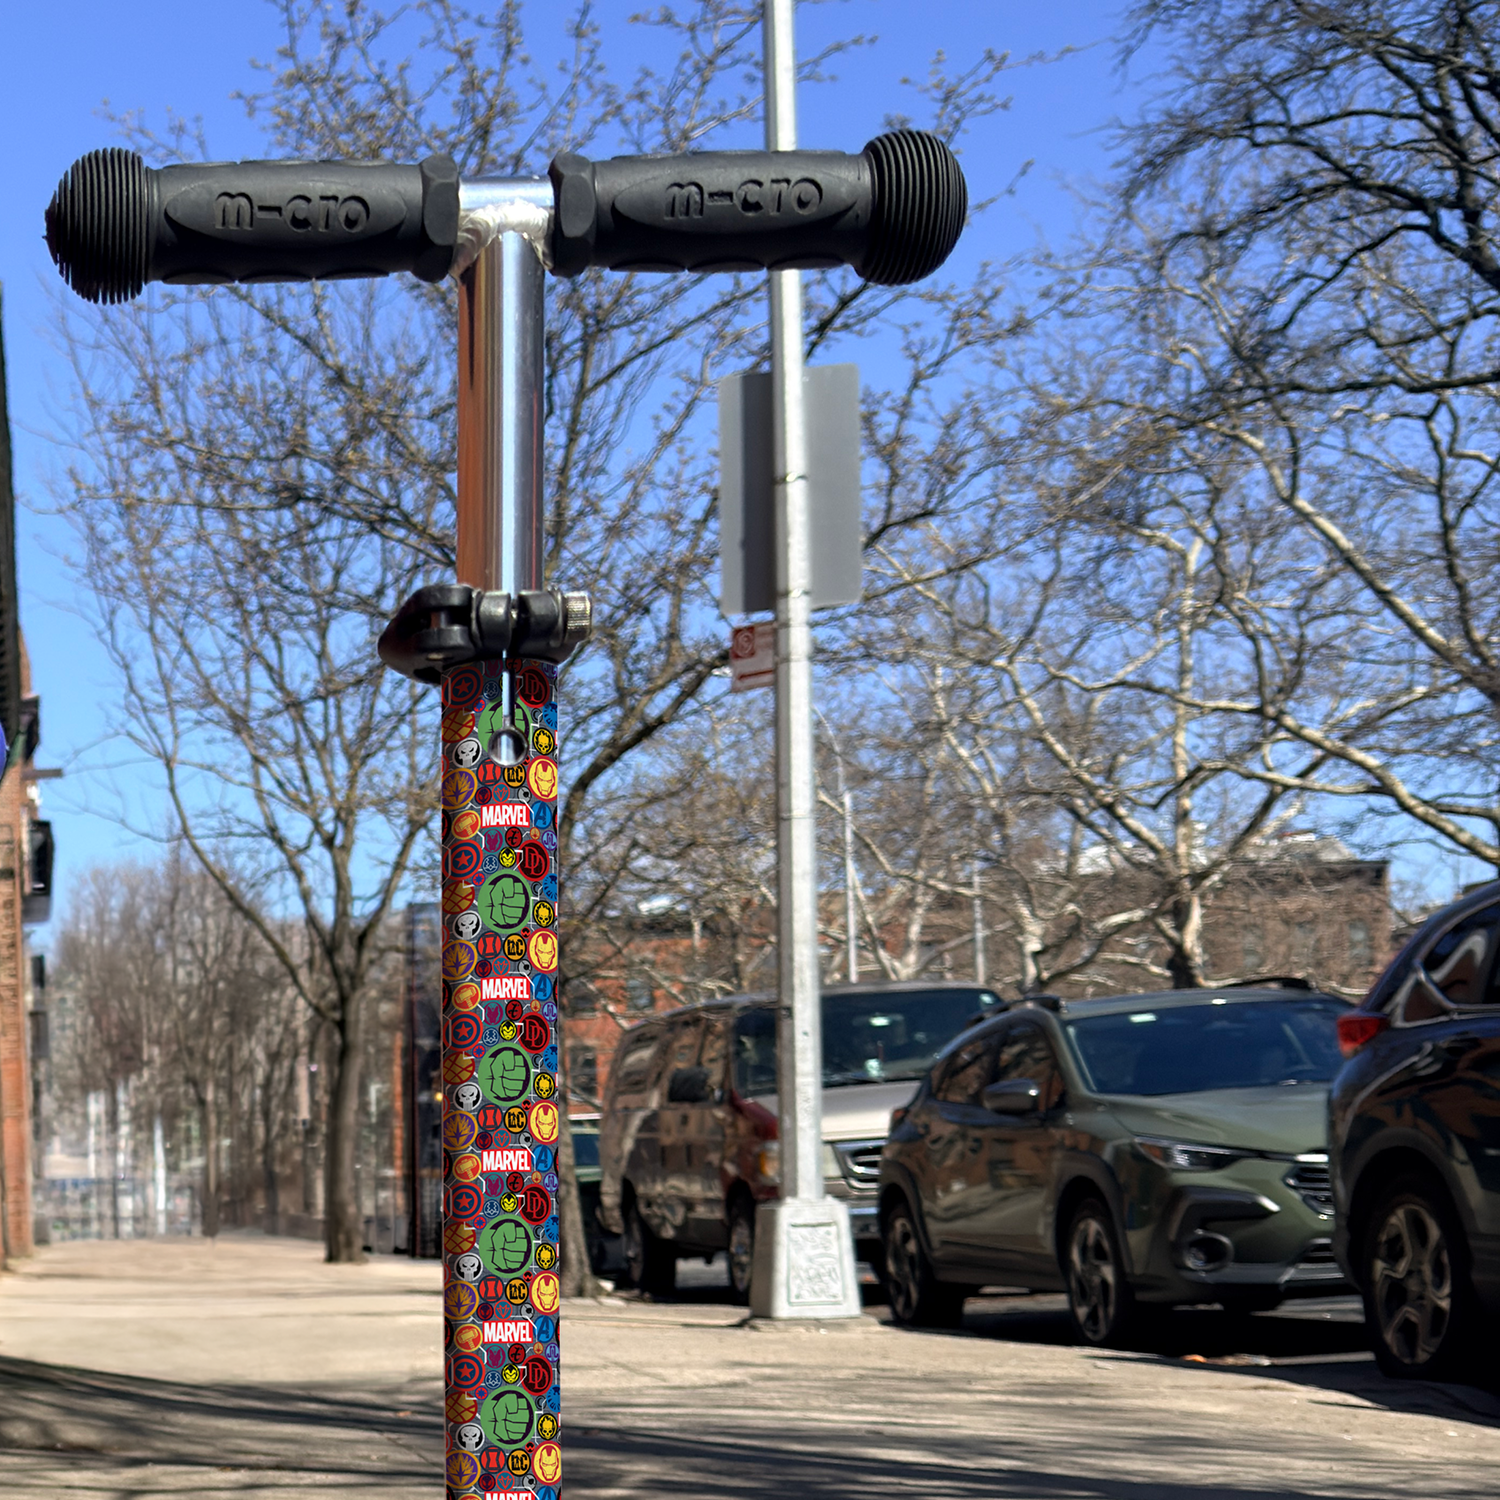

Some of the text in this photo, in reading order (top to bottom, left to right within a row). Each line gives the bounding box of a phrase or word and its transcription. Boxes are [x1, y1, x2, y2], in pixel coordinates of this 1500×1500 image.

[481, 805, 529, 825] MARVEL
[481, 978, 529, 998] MARVEL
[482, 1150, 530, 1170] MARVEL
[483, 1321, 532, 1342] MARVEL
